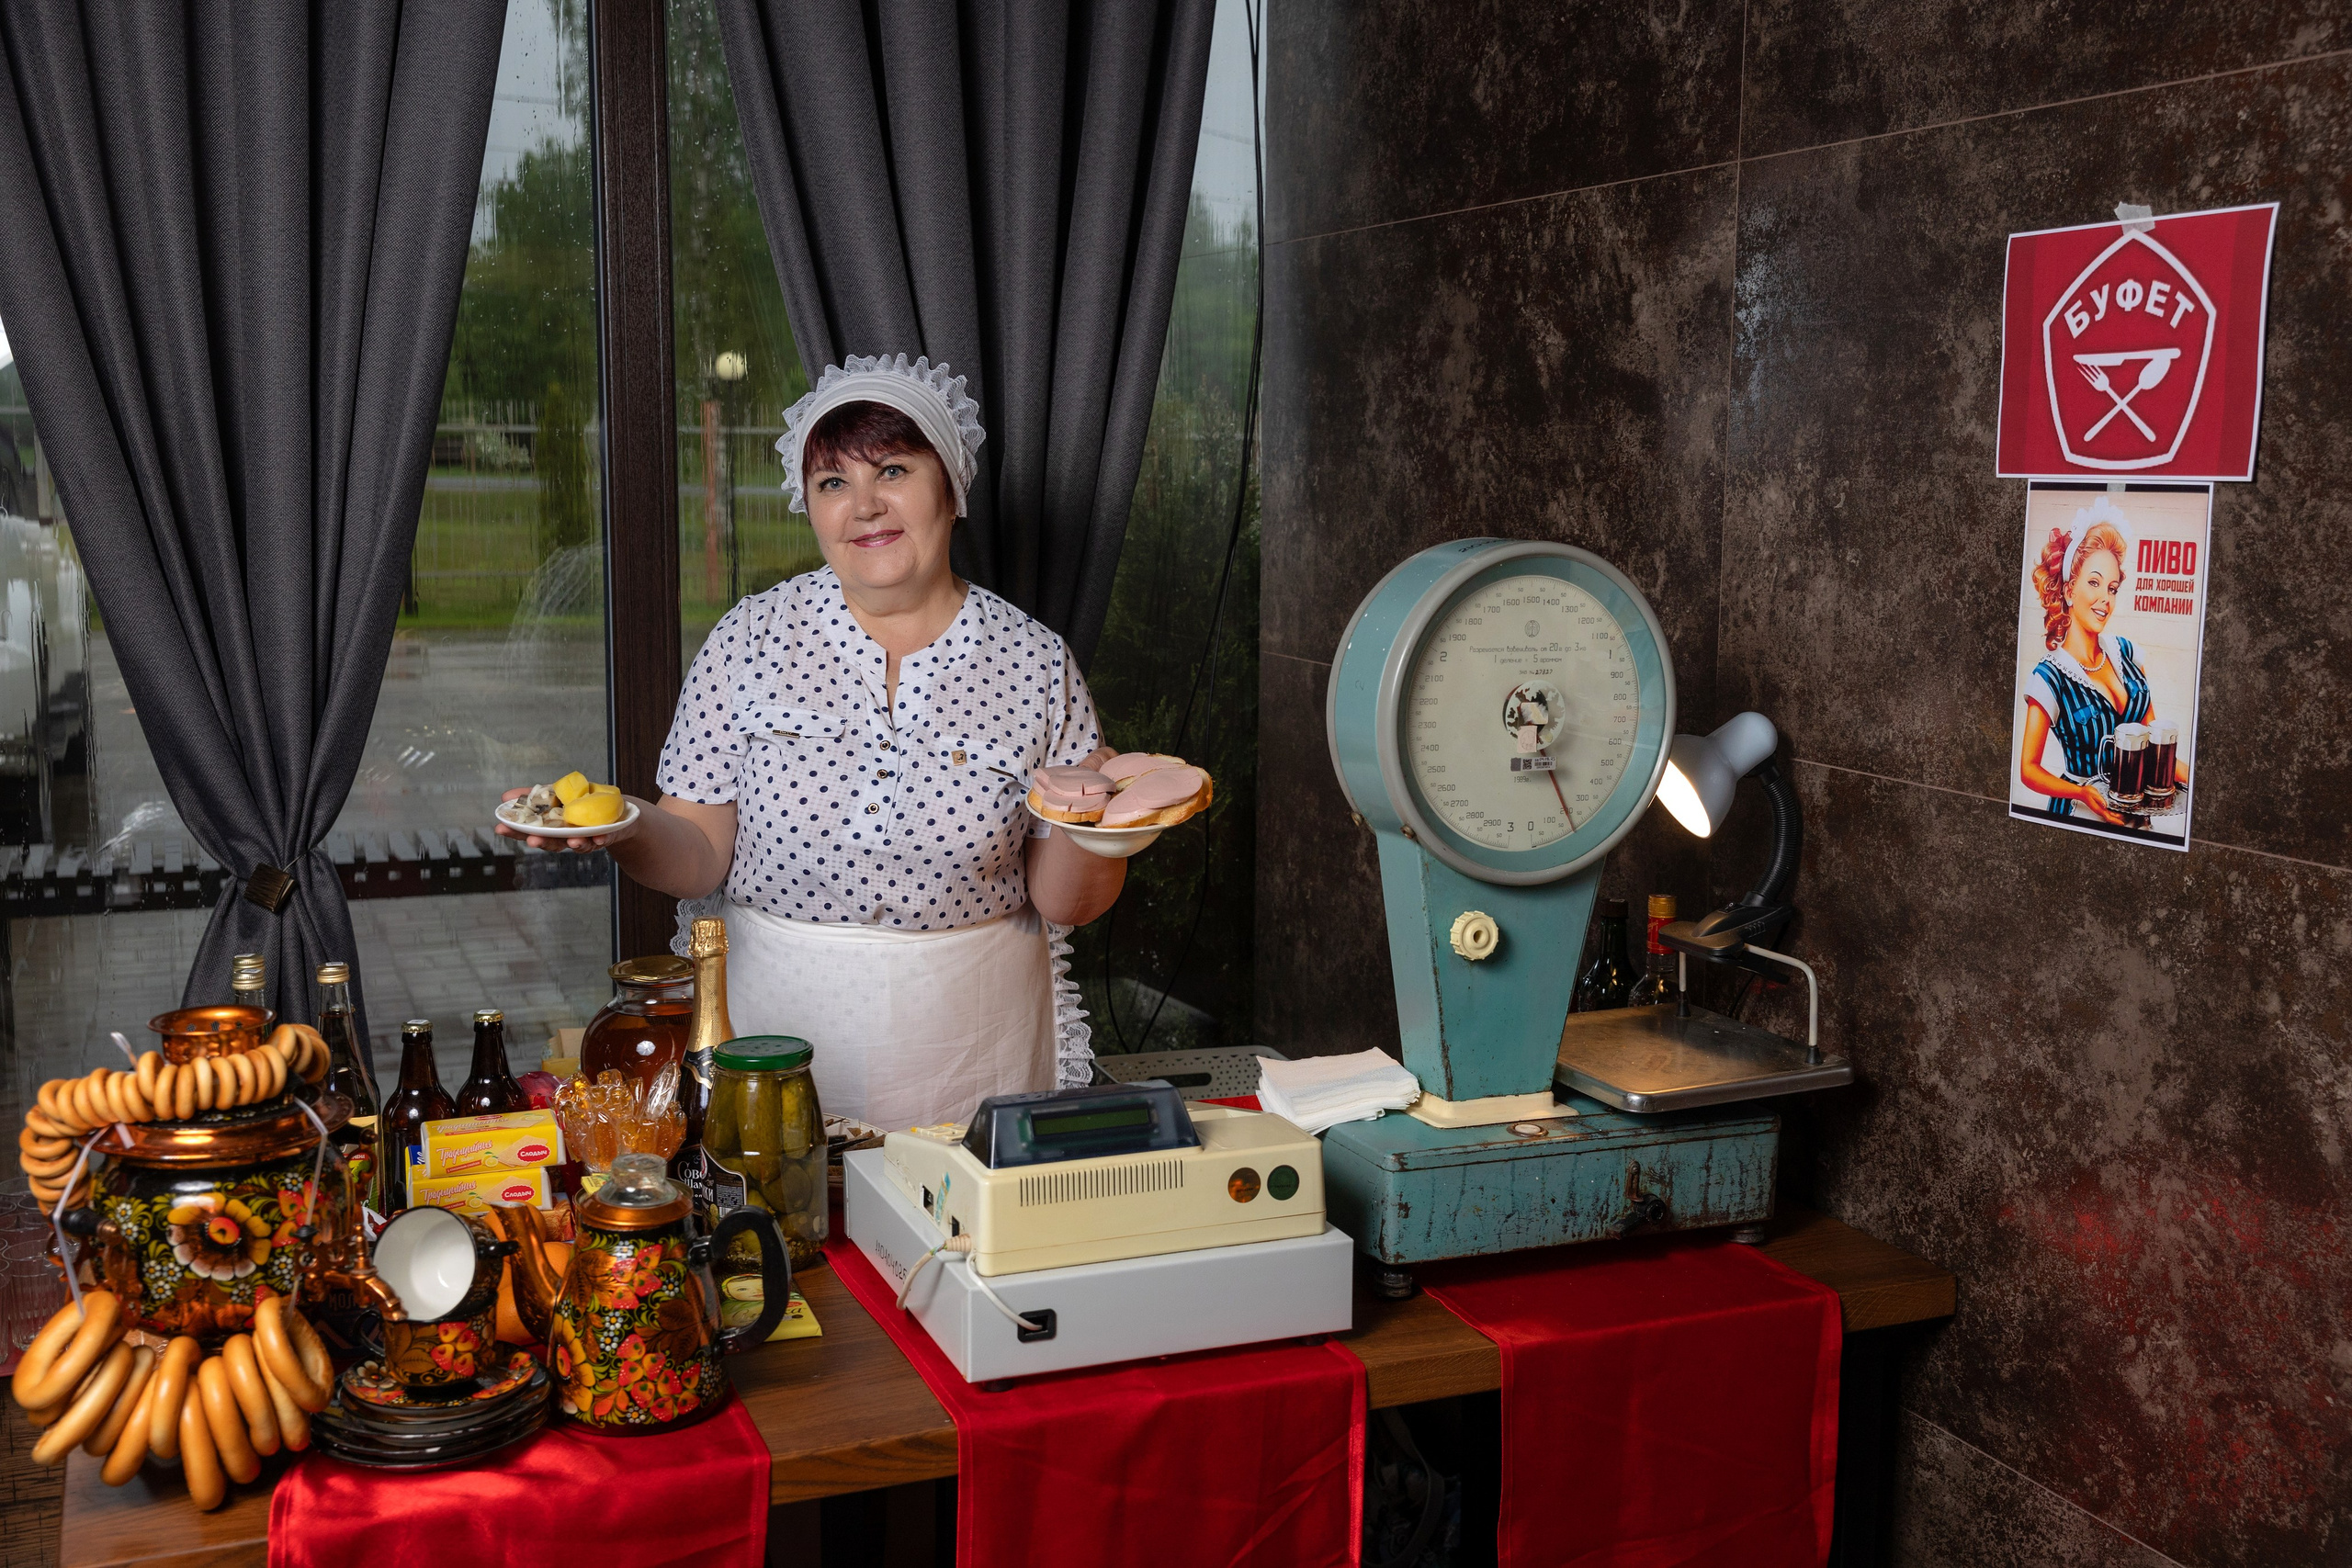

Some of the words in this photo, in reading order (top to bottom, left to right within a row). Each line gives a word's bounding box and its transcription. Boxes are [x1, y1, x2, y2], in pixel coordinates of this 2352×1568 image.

[2064, 278, 2195, 339] БУФЕТ
[2137, 539, 2197, 575] ПИВО
[2135, 578, 2154, 591] ДЛЯ
[2156, 579, 2194, 593] ХОРОШЕЙ
[2134, 595, 2193, 615] КОМПАНИИ
[1440, 651, 1447, 661] 2
[1533, 654, 1538, 662] 5
[1507, 822, 1514, 832] 3
[1528, 821, 1533, 830] 0
